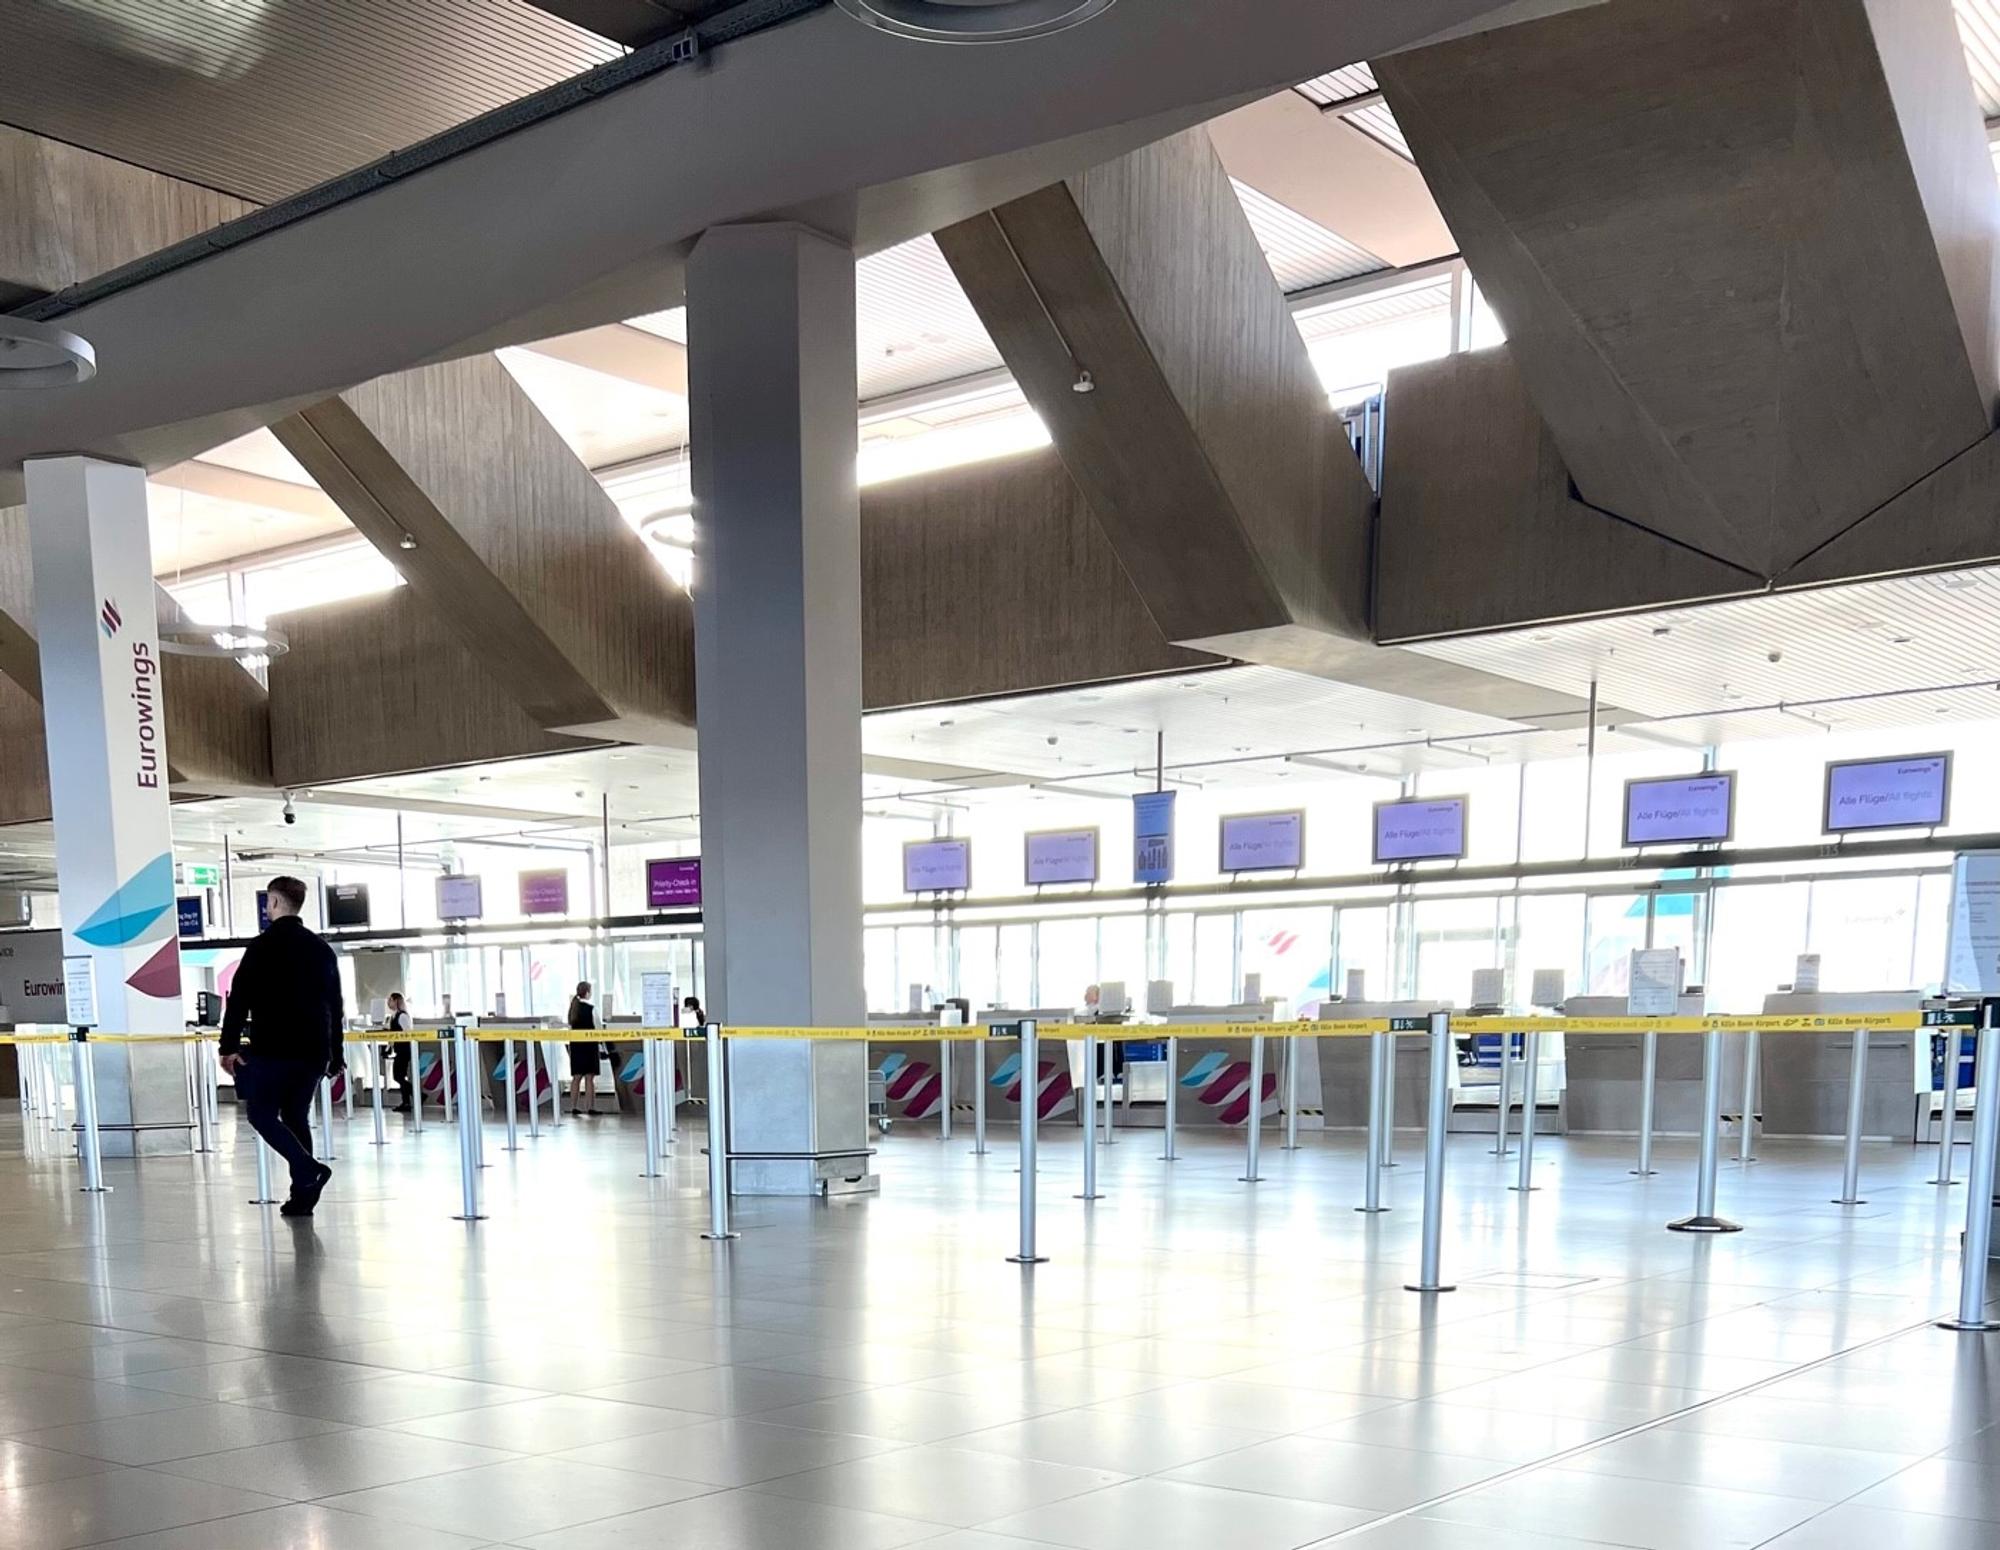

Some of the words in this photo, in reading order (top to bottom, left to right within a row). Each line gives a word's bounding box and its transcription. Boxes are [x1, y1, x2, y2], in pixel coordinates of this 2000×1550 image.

[132, 641, 158, 789] Eurowings
[1838, 796, 1857, 806] Alle
[1636, 810, 1653, 820] Alle
